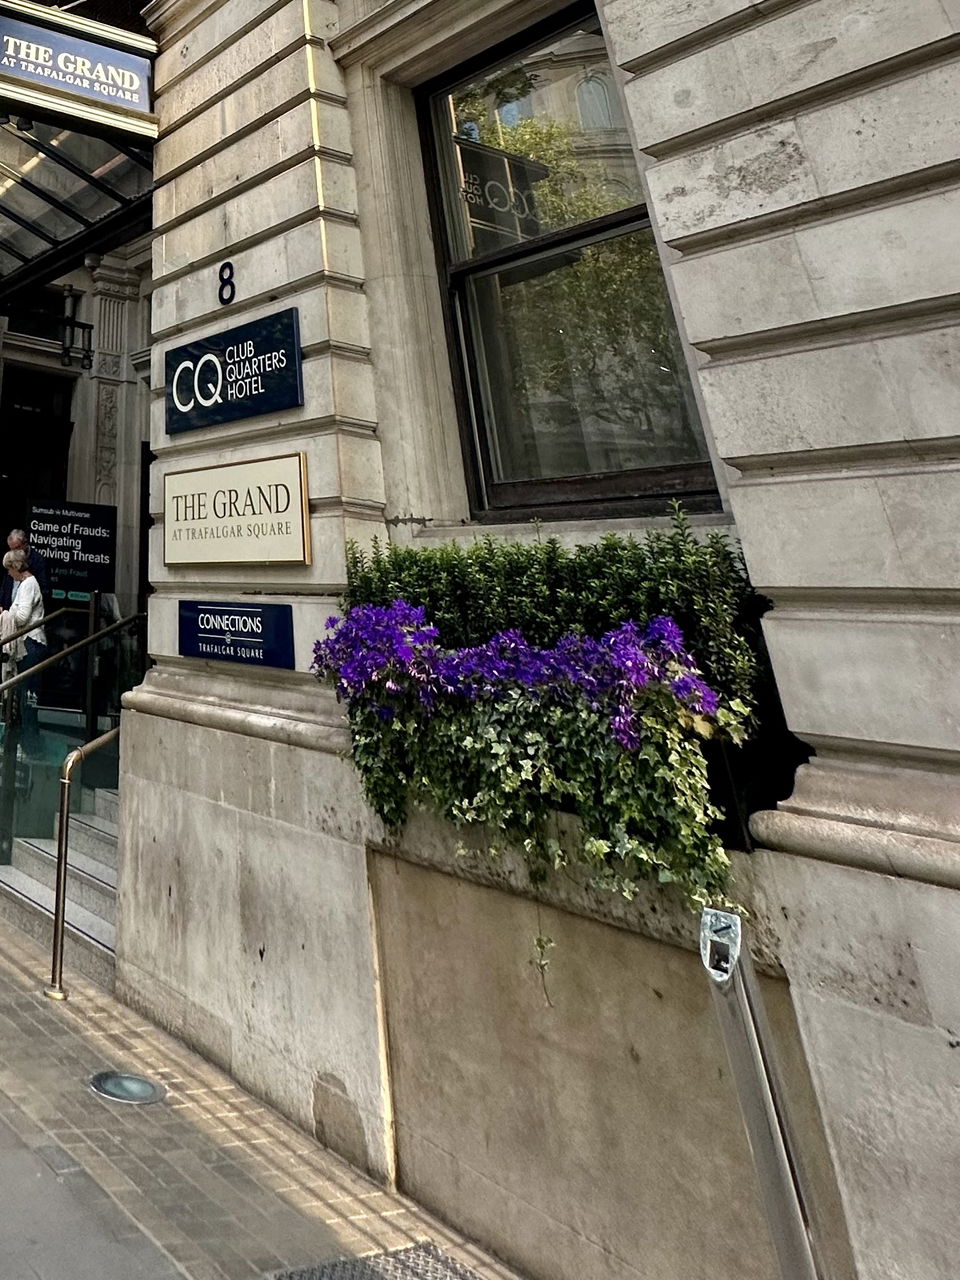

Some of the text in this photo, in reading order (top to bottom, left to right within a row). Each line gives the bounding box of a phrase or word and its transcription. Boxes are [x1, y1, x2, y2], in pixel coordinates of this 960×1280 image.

[3, 35, 141, 91] THE GRAND
[1, 56, 140, 103] AT TRAFALGAR SQUARE
[218, 261, 236, 305] 8
[225, 340, 255, 363] CLUB
[226, 350, 287, 382] QUARTERS
[172, 353, 223, 412] CQ
[227, 376, 265, 401] HOTEL
[172, 483, 291, 522] THE GRAND
[30, 520, 110, 537] Game of Frauds:
[171, 521, 292, 541] AT TRAFALGAR SQUARE
[29, 532, 82, 550] Navigating
[72, 550, 110, 564] Threats
[198, 613, 263, 634] CONNECTIONS
[198, 643, 264, 659] TRAFALGAR SQUARE
